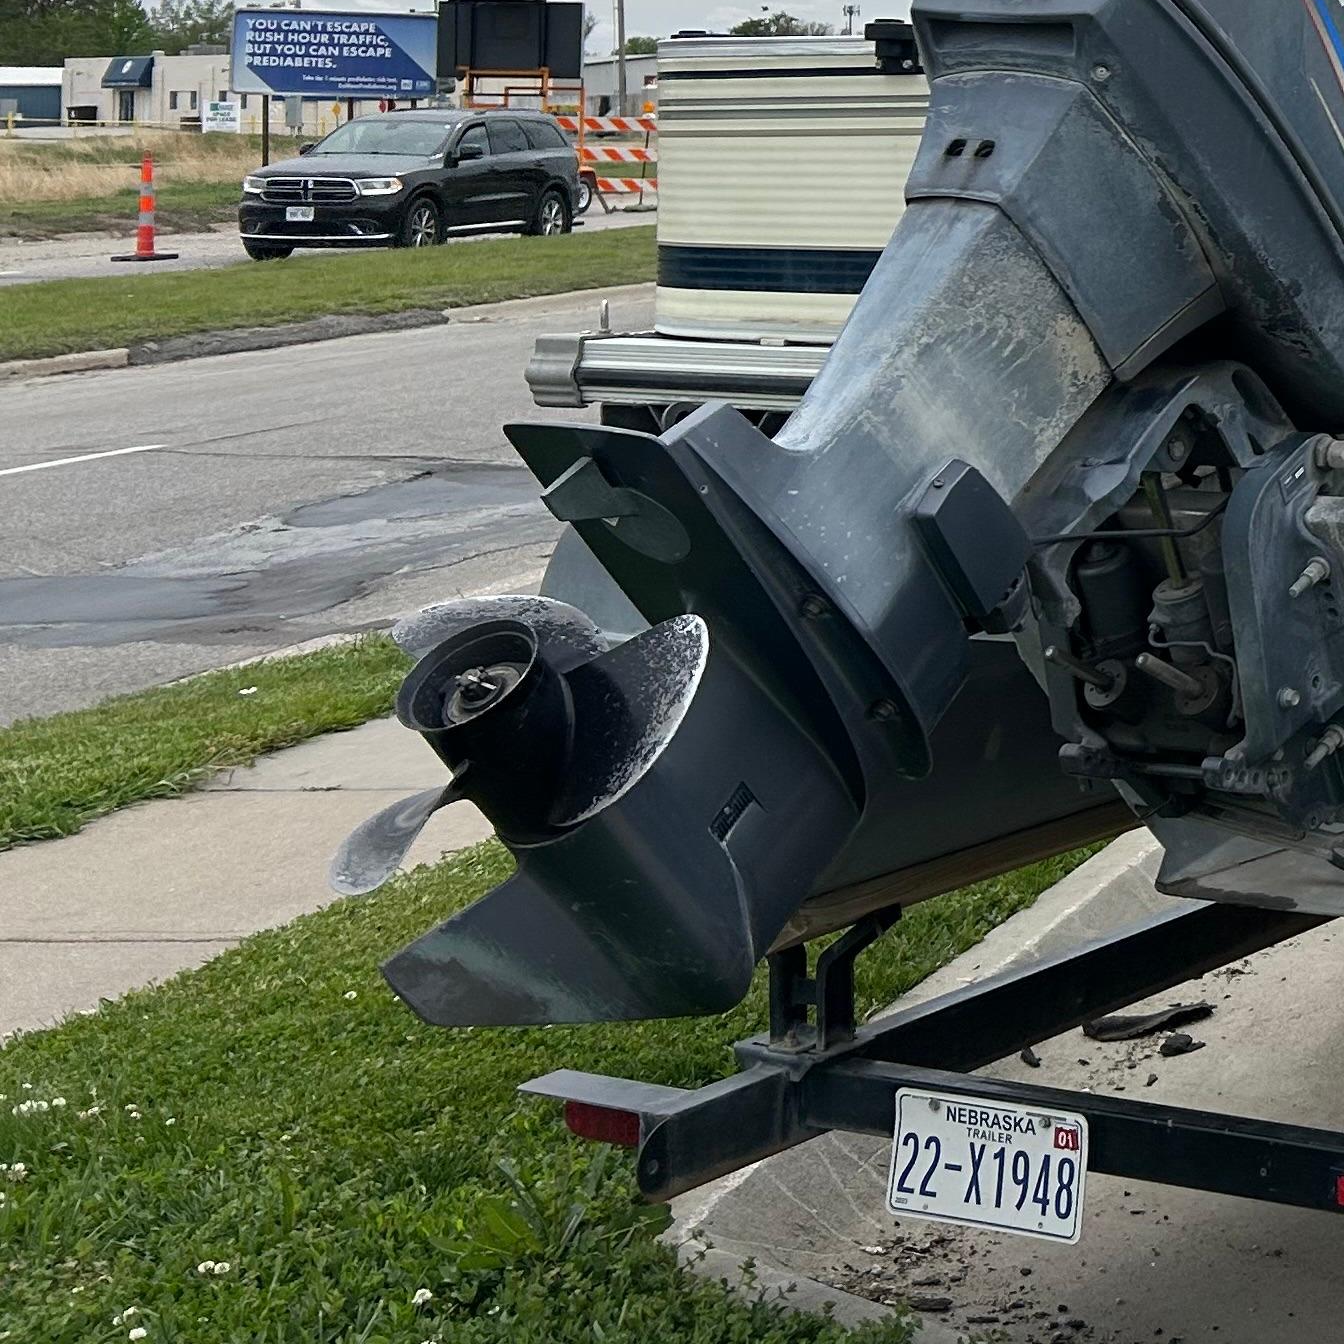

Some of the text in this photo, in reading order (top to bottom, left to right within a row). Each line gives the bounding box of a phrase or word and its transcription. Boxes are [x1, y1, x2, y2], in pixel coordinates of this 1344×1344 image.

[246, 18, 377, 33] YOU CAN'T ESCAPE
[245, 31, 389, 47] RUSH HOUR TRAFFIC,
[245, 43, 393, 58] BUT YOU CAN ESCAPE
[245, 54, 337, 69] PREDIABETES.
[946, 1105, 1036, 1136] NEBRASKA
[966, 1127, 1013, 1144] TRAILER
[1058, 1131, 1073, 1148] 01
[897, 1132, 1075, 1220] 22-X1948
